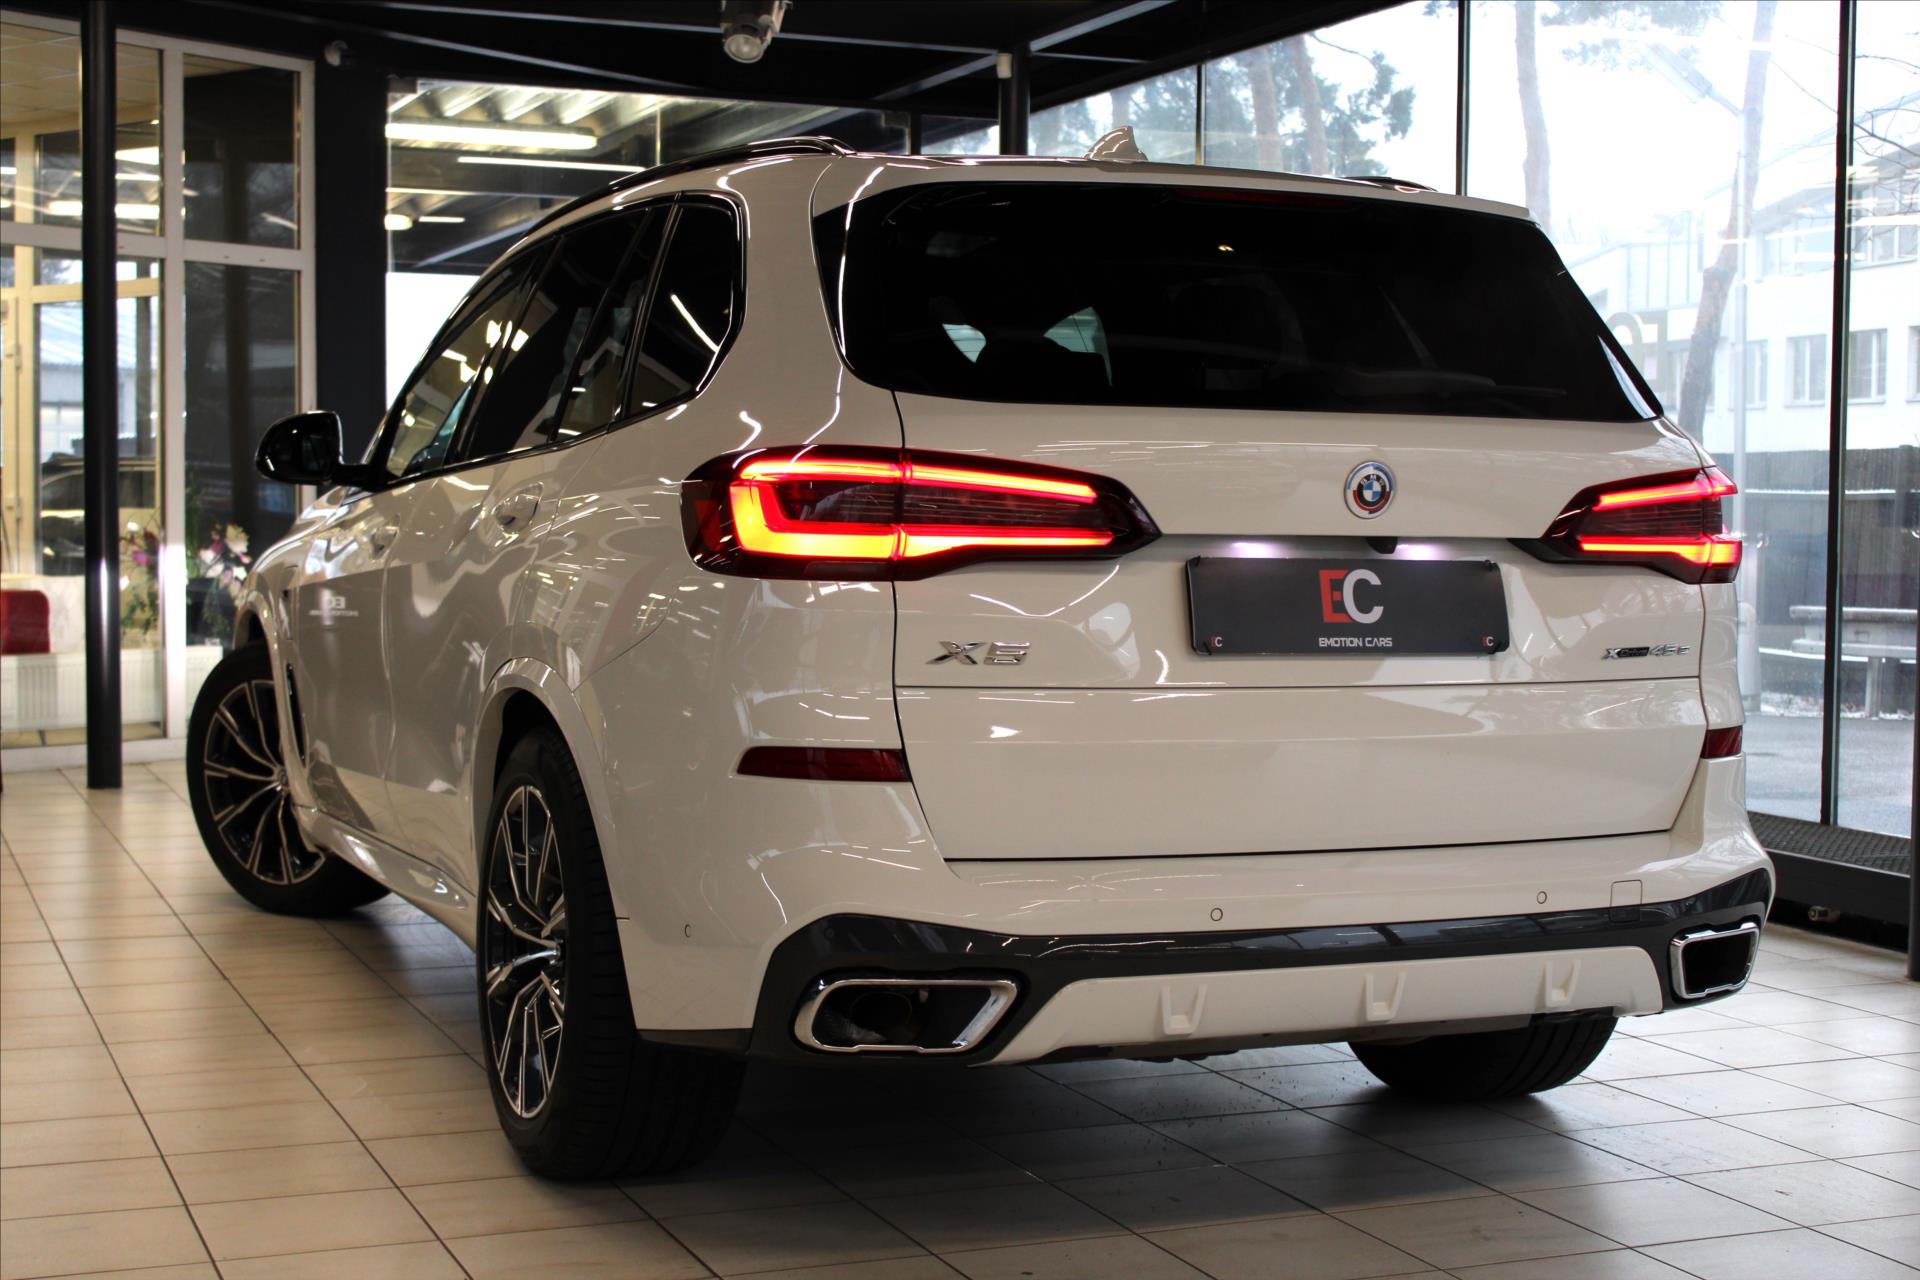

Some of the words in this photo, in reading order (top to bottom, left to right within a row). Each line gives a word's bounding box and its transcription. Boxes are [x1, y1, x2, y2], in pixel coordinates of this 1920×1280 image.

[1319, 568, 1384, 624] EC
[925, 640, 1031, 666] X5
[1318, 637, 1363, 647] EMOTION
[1365, 638, 1393, 647] CARS
